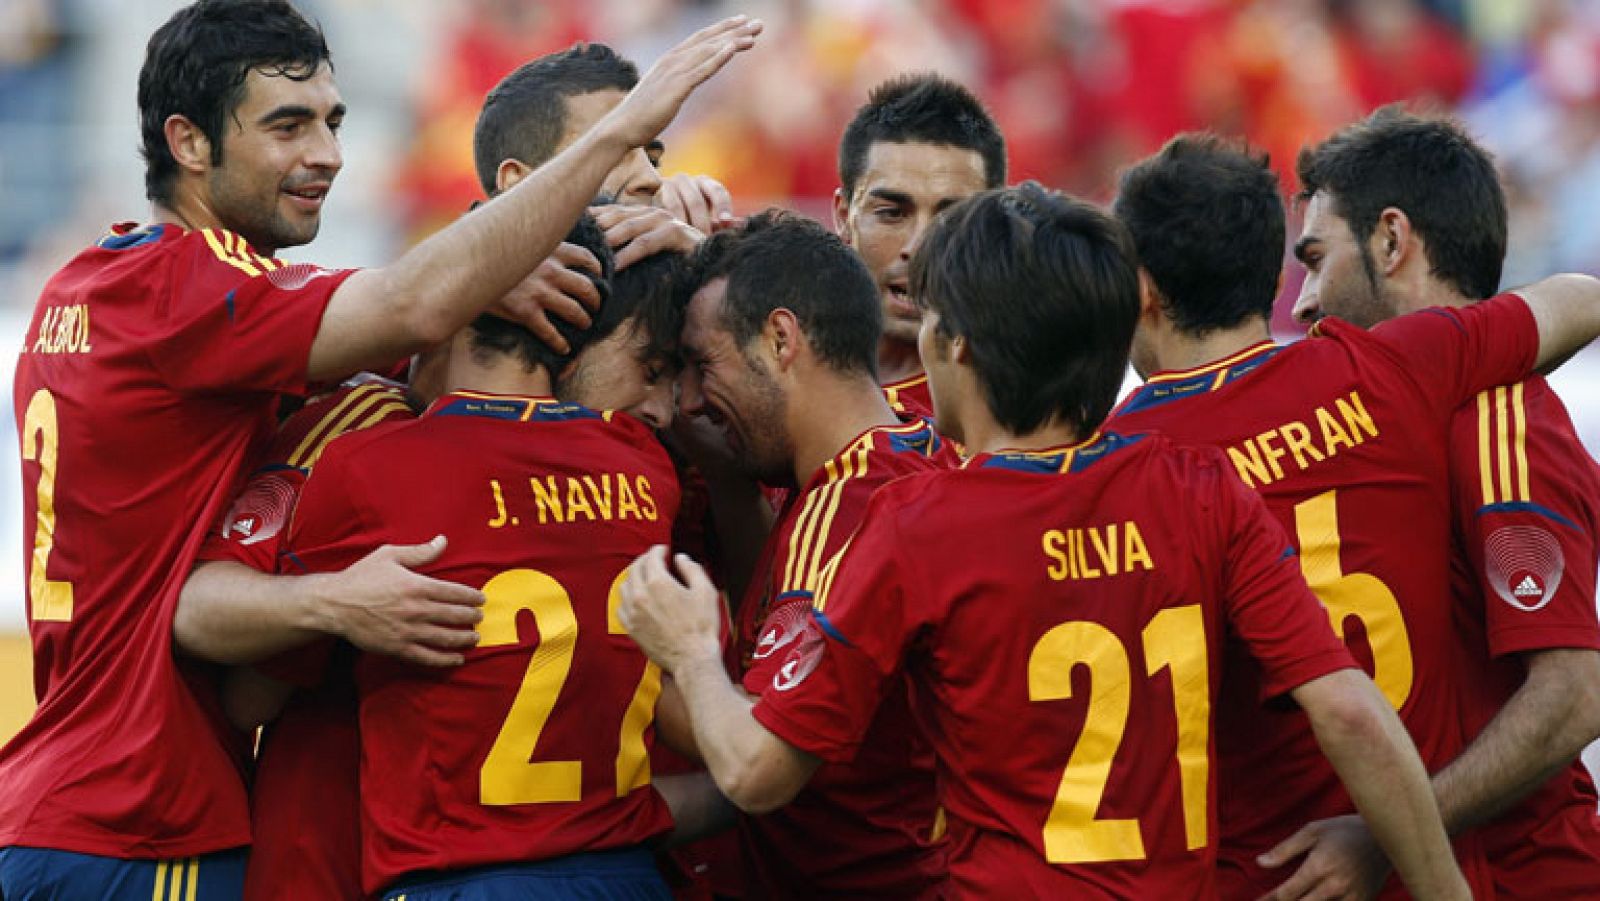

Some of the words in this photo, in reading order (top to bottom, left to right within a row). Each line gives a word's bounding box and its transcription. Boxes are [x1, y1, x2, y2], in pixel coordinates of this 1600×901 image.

[33, 304, 92, 354] ALBIOL
[23, 387, 74, 623] 2
[487, 479, 520, 529] J.
[530, 473, 658, 524] NAVAS
[1042, 521, 1154, 581] SILVA
[1028, 604, 1210, 864] 21
